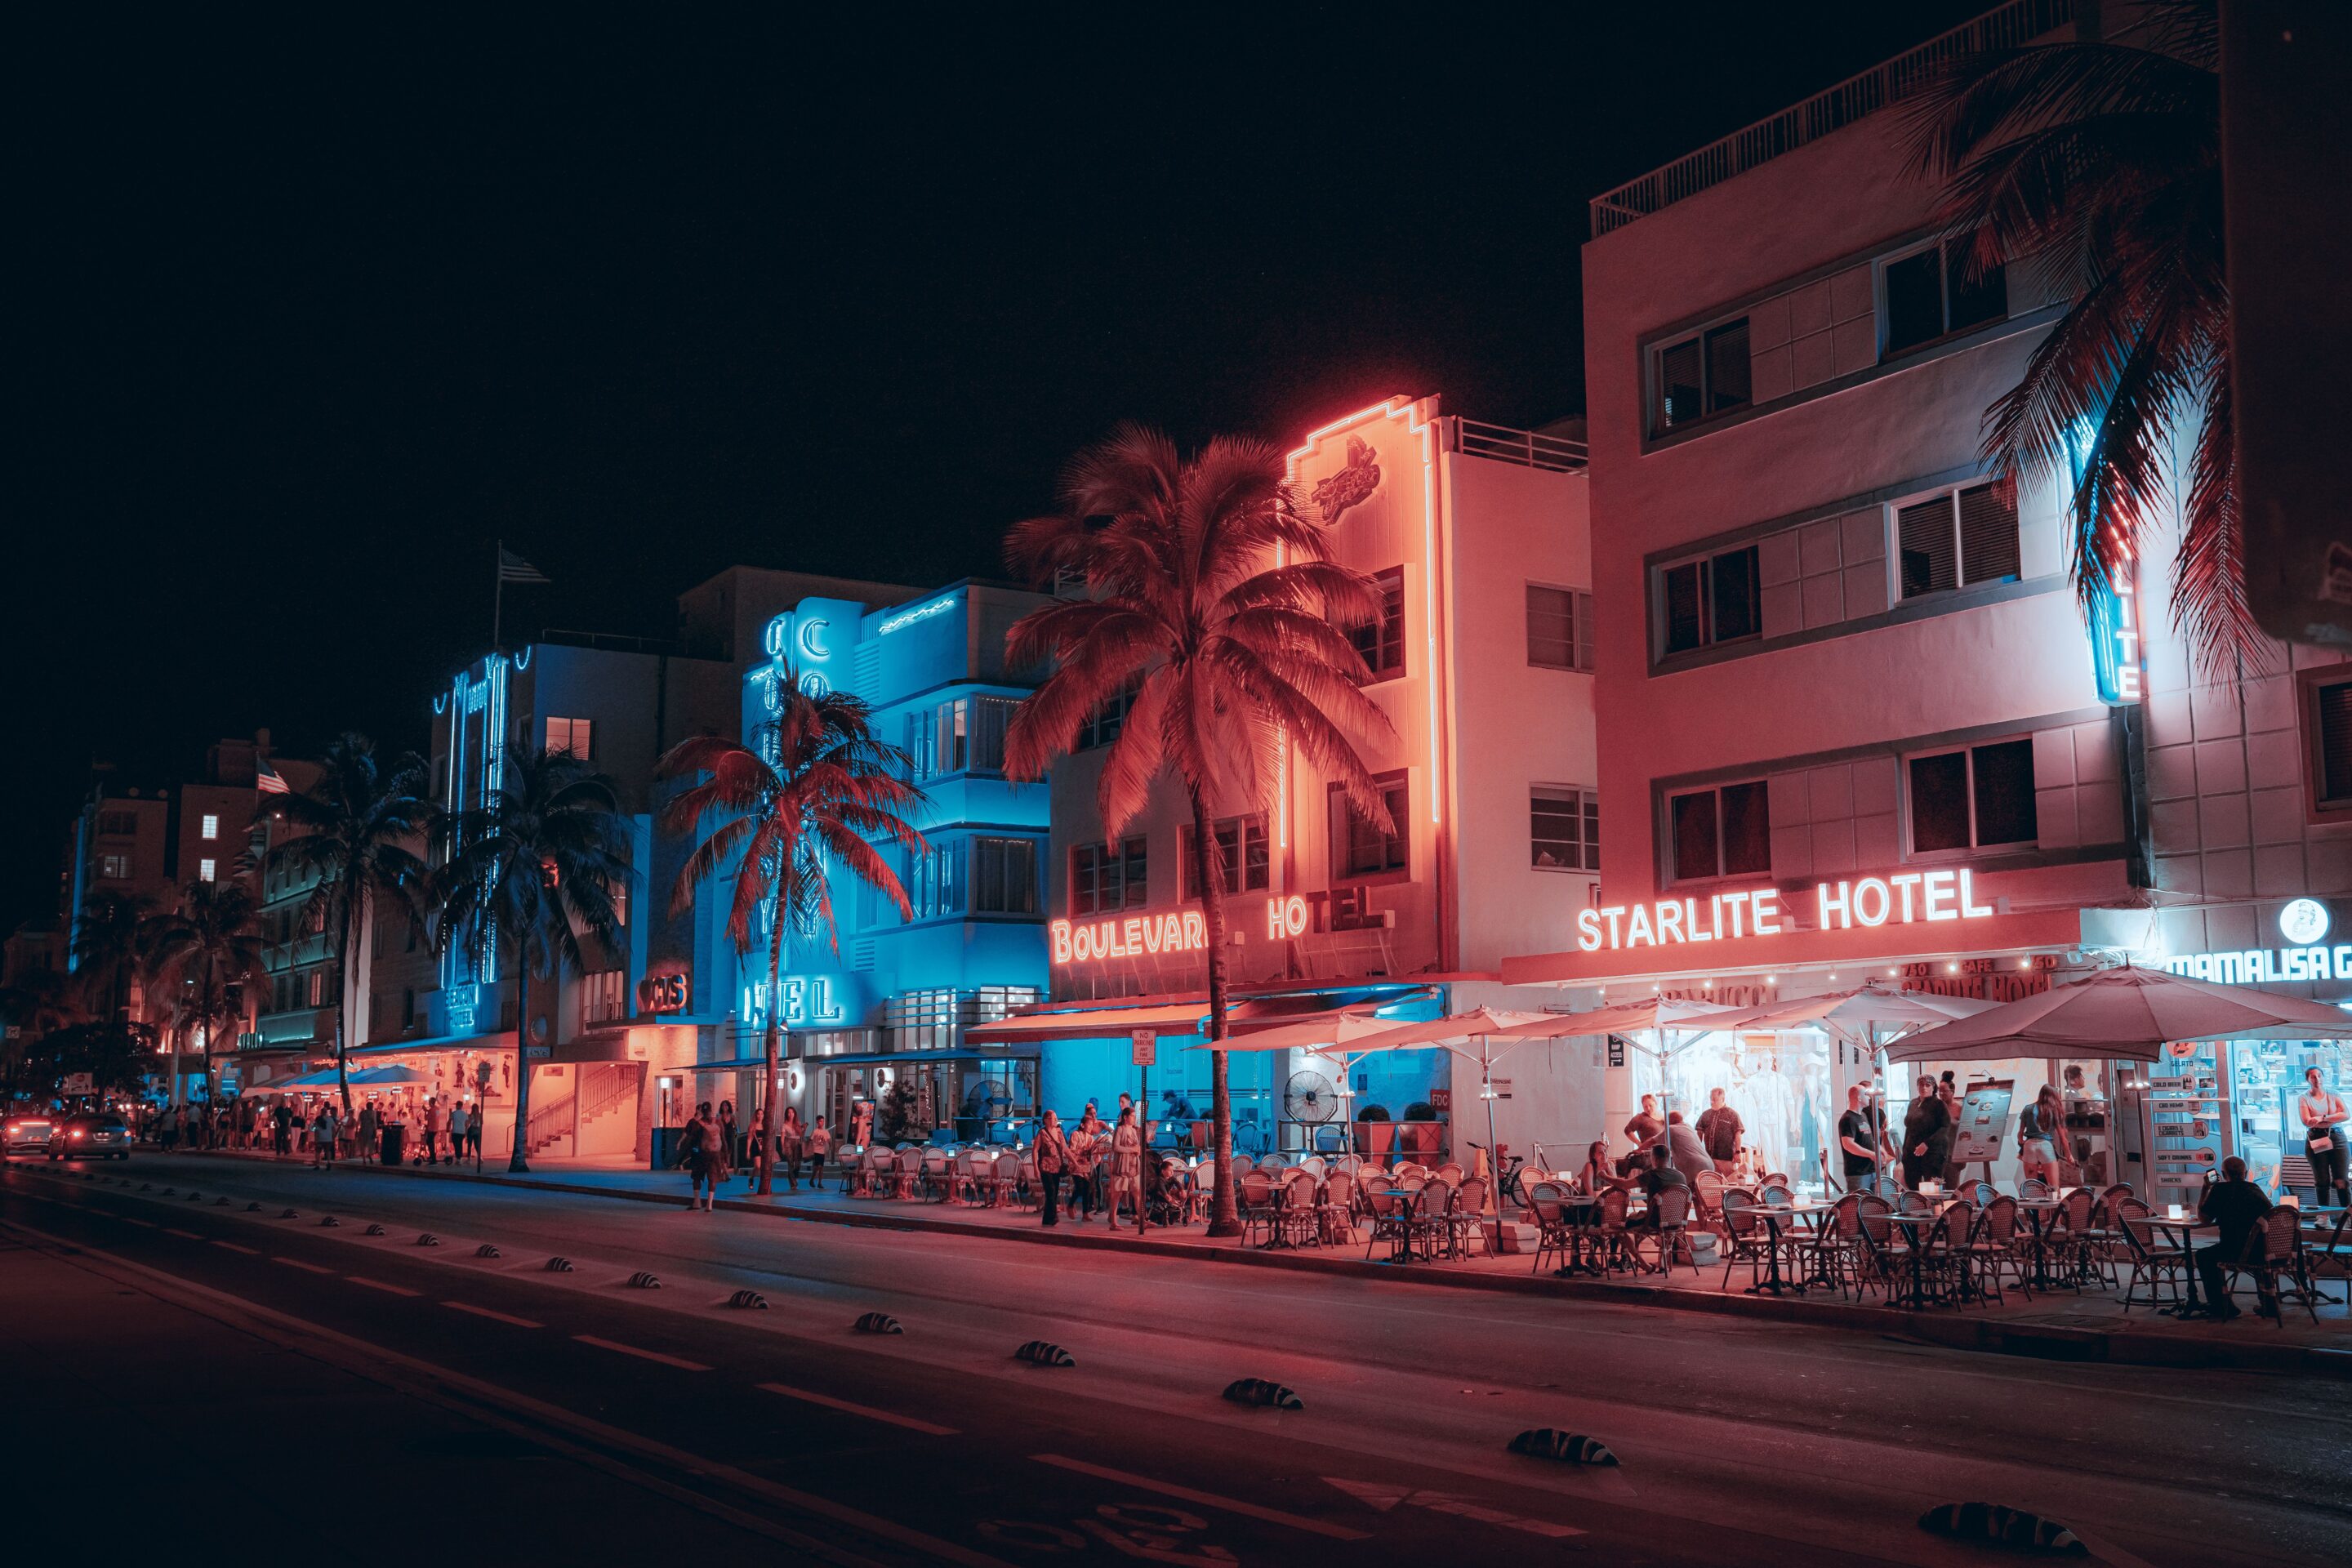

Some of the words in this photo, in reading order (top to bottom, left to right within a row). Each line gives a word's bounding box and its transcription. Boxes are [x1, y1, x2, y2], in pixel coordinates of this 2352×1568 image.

[1267, 886, 1386, 940] HOTEL
[1578, 889, 1781, 951] STARLITE
[1819, 868, 1993, 930] HOTEL
[2031, 955, 2058, 969] 50
[2166, 946, 2331, 984] MAMALISA
[653, 974, 688, 1009] CVS
[1432, 1094, 1448, 1107] FDC
